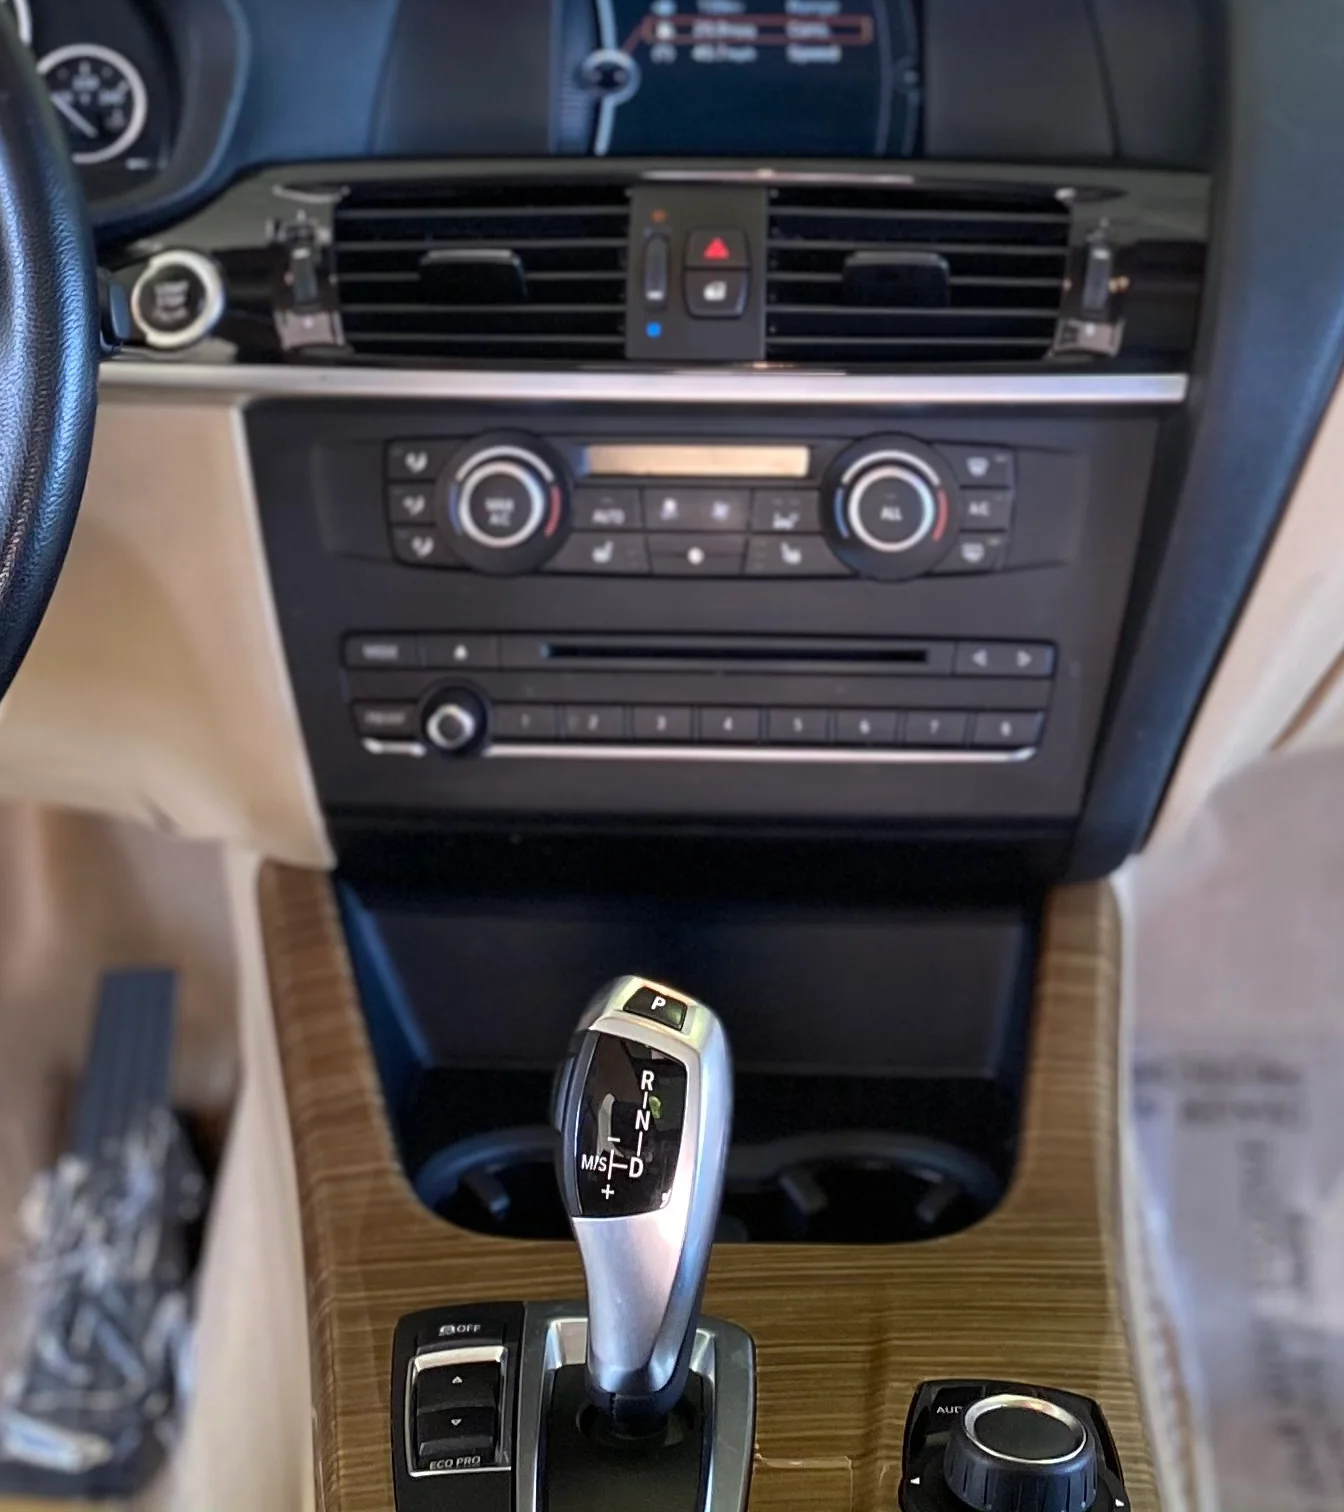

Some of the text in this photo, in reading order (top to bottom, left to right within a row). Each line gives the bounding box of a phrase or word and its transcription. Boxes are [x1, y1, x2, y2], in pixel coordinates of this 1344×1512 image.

[591, 508, 626, 525] AUTO
[879, 506, 902, 522] ALL
[722, 716, 733, 731] 4
[651, 996, 666, 1010] P
[640, 1070, 655, 1091] R
[635, 1110, 651, 1131] N
[581, 1154, 644, 1178] M/S D
[456, 1324, 481, 1333] OFF
[429, 1456, 481, 1470] ECO PRO
